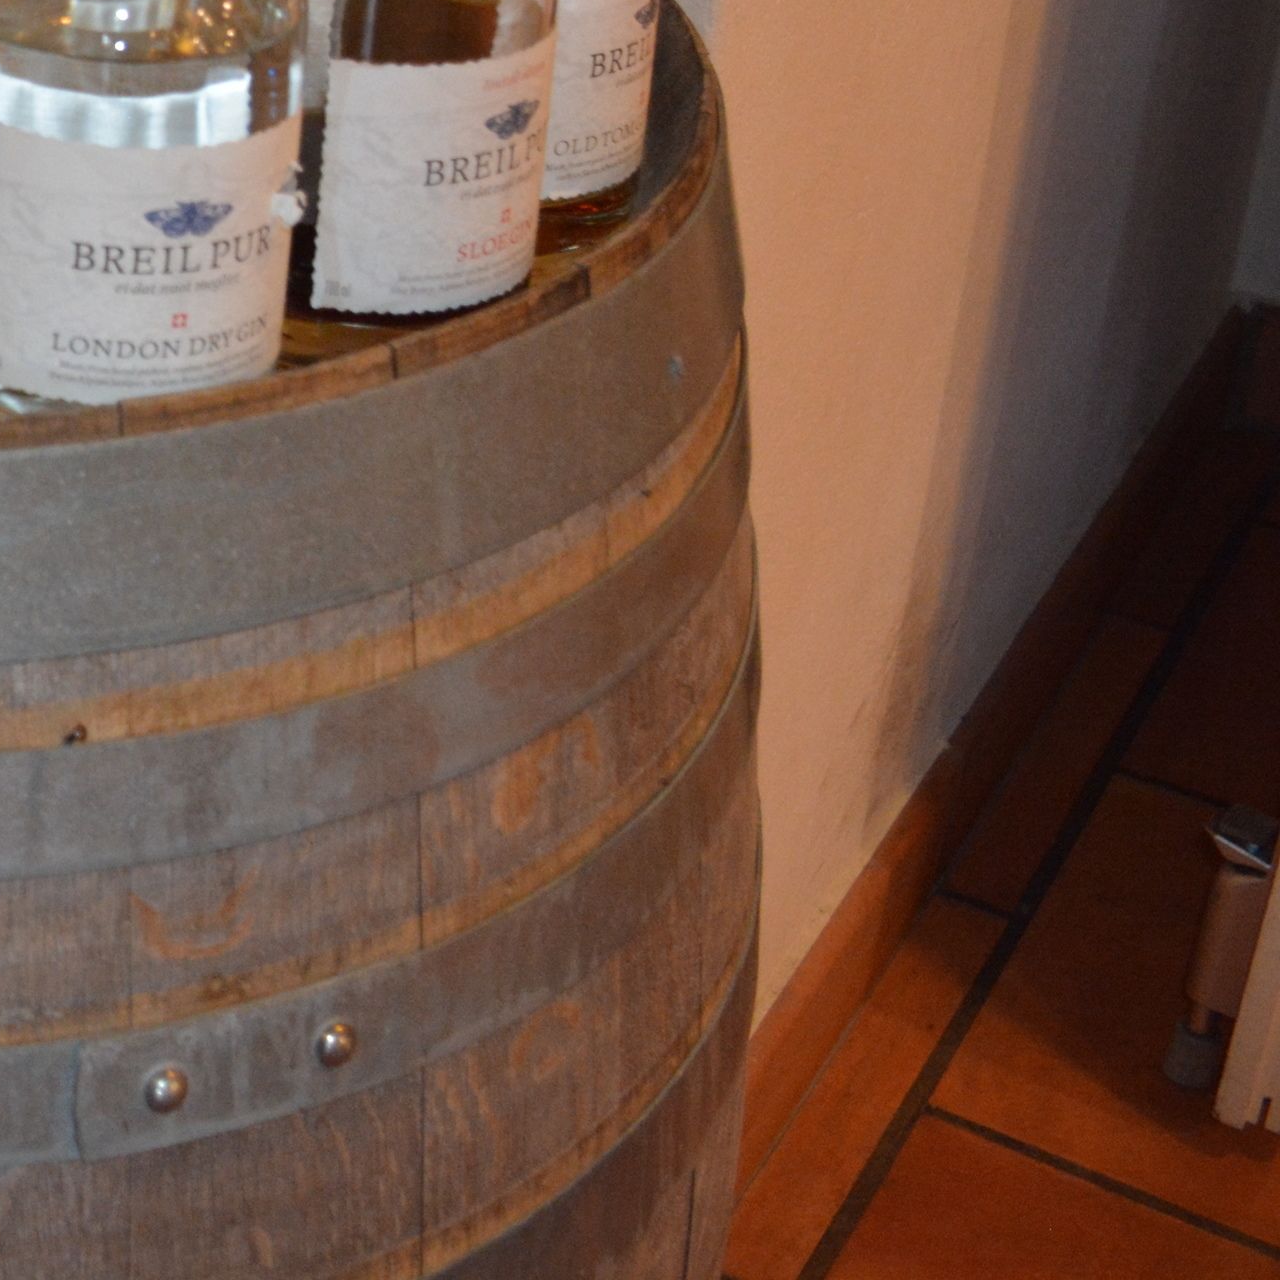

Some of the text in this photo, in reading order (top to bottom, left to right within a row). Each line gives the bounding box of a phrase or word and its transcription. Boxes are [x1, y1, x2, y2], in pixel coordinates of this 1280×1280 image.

[554, 135, 598, 156] OLD
[424, 144, 520, 187] BREIL
[72, 225, 271, 275] BREIL PUR
[52, 332, 180, 359] LONDON
[189, 327, 233, 357] DRY
